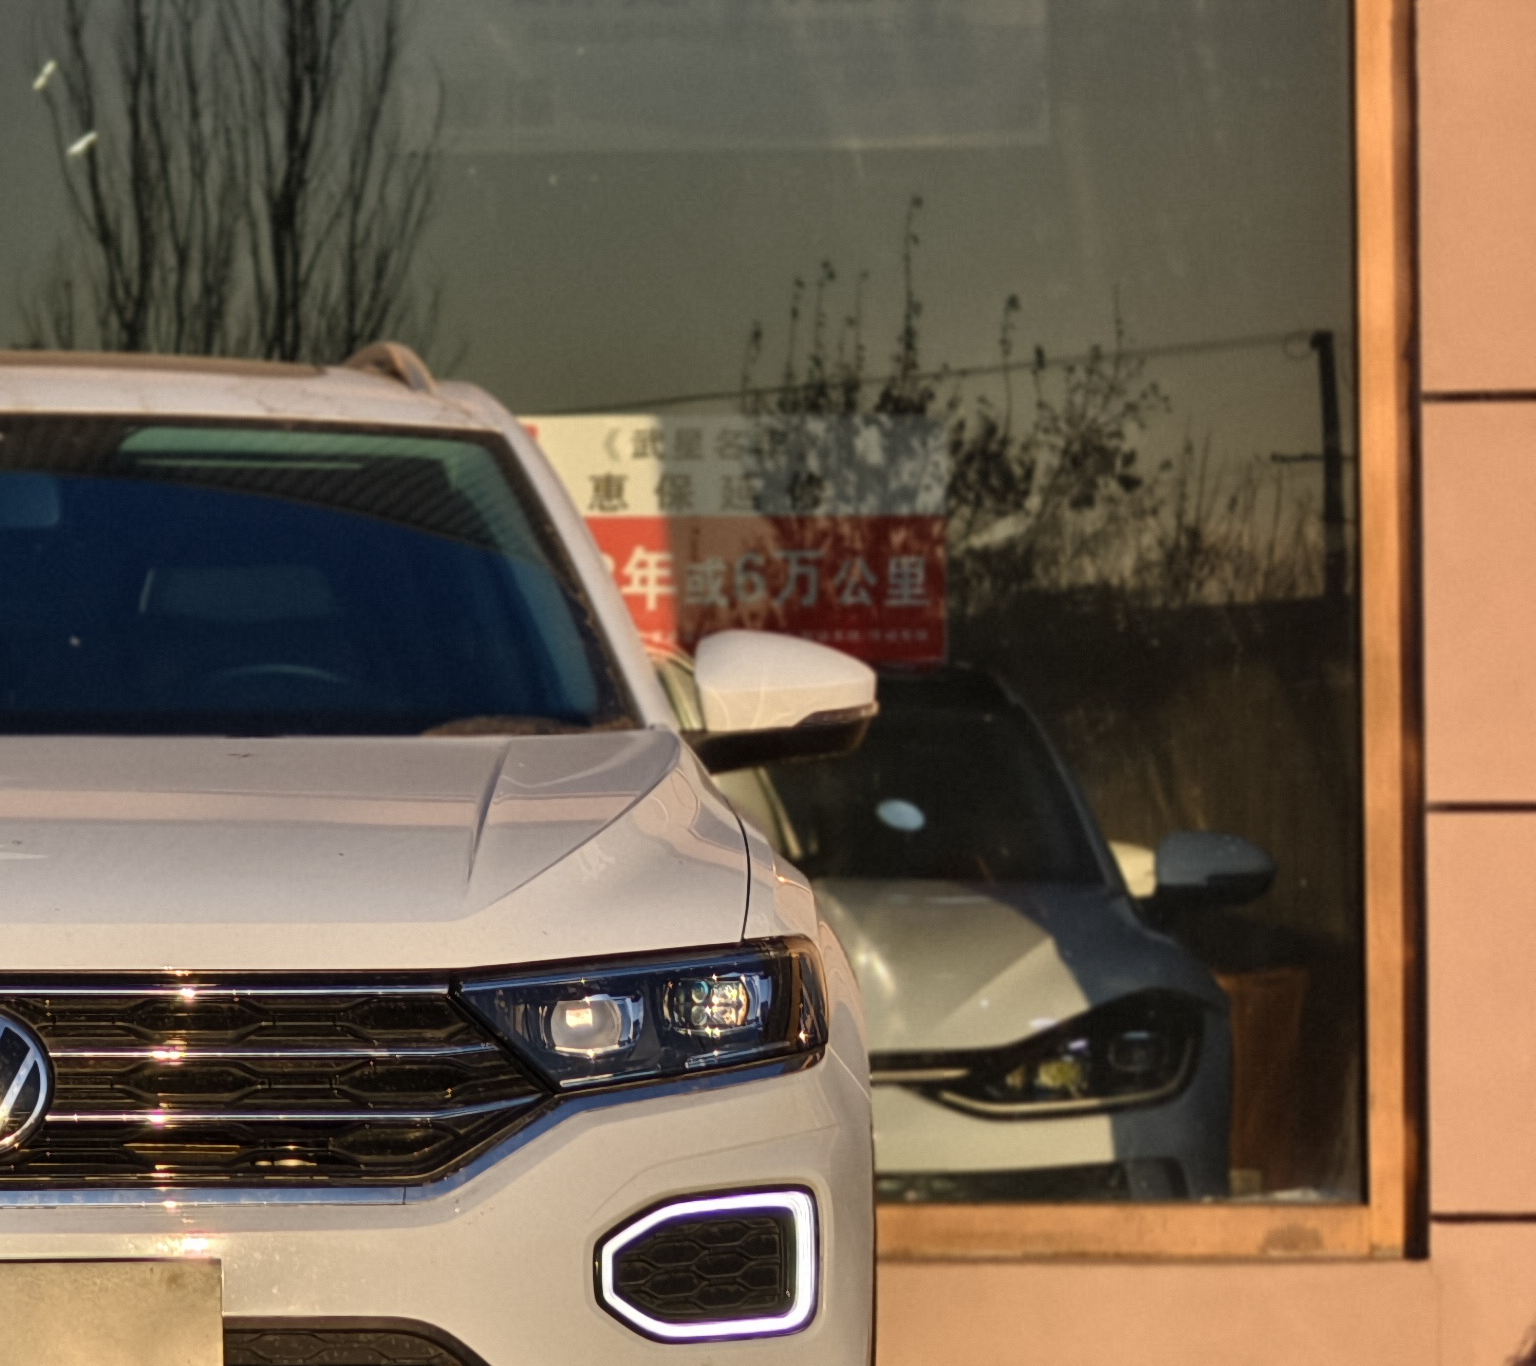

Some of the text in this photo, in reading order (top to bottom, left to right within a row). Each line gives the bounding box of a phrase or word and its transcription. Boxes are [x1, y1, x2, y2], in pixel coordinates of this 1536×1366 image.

[601, 544, 930, 612] 年或6万公里
